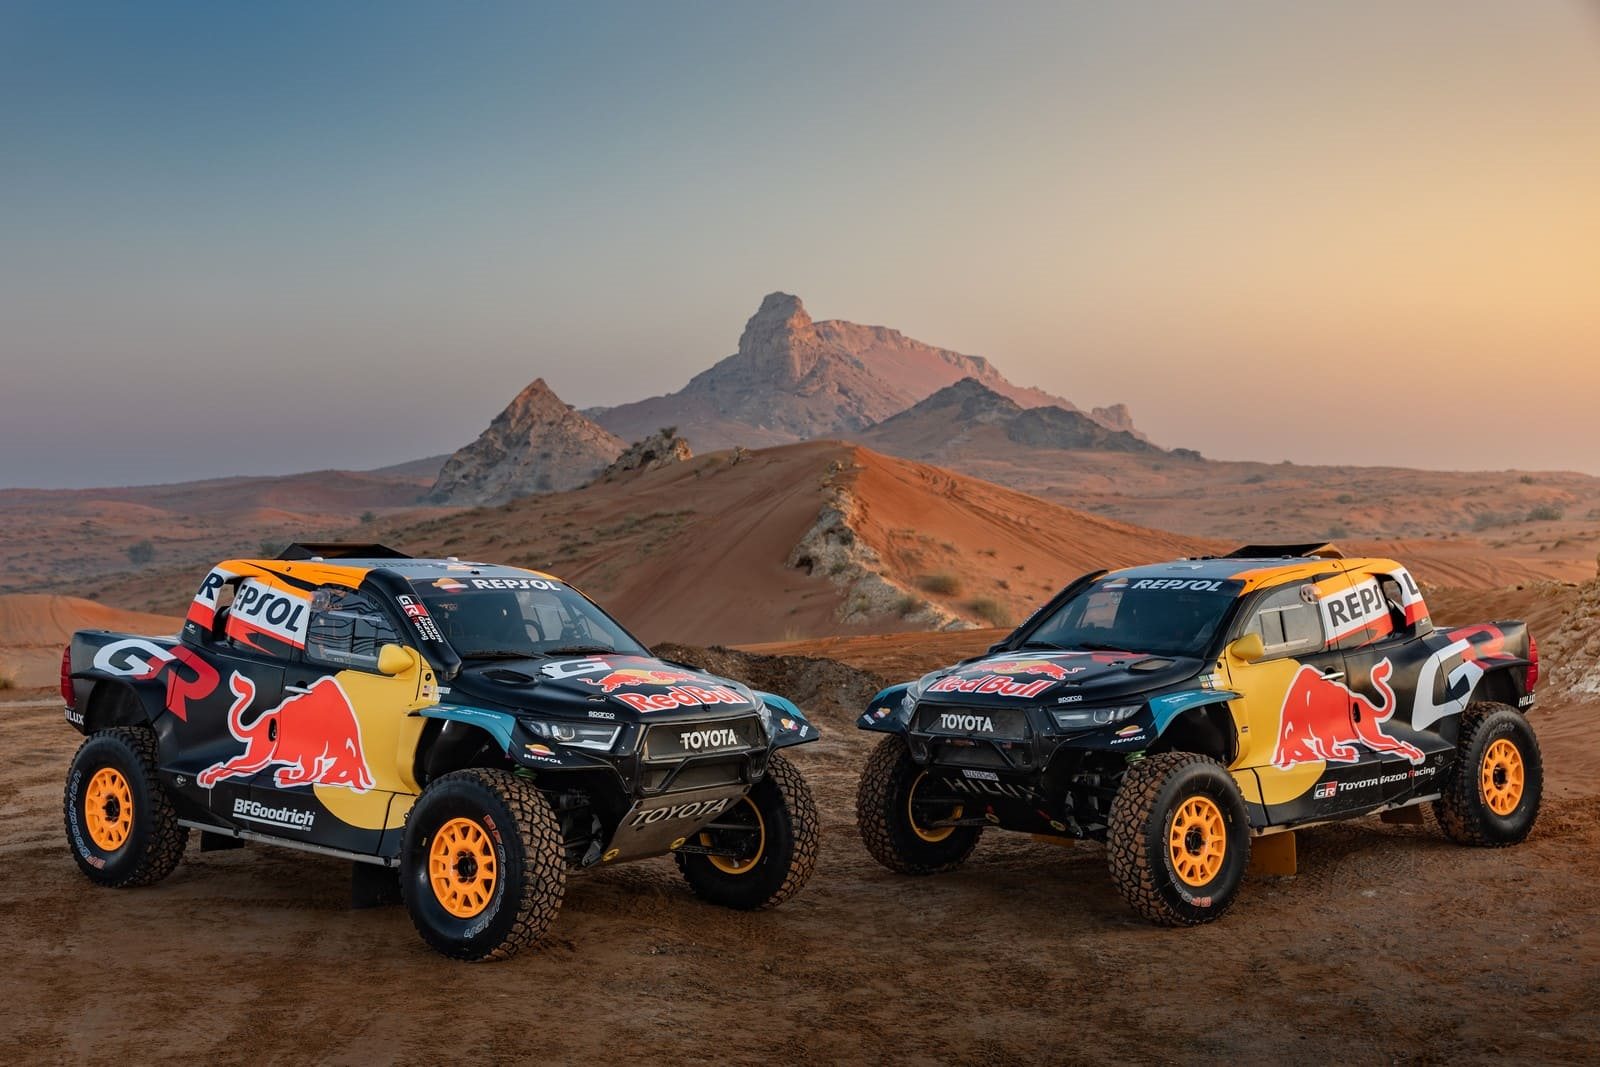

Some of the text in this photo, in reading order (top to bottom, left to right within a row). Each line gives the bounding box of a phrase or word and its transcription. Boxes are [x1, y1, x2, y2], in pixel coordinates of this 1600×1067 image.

[471, 579, 561, 591] REPSOL
[1131, 579, 1223, 592] REPSOL
[396, 595, 421, 617] GR
[93, 638, 221, 722] GR
[927, 675, 1056, 698] Red Bull
[613, 686, 749, 713] Red Bull
[941, 713, 994, 732] TOYOTA
[681, 729, 738, 750] TOYOTA
[1110, 734, 1146, 745] REPSOL
[523, 753, 562, 765] REPSOL
[1314, 783, 1337, 799] GR
[1339, 778, 1378, 791] TOYOTA
[1408, 767, 1435, 779] Racing
[233, 798, 315, 826] BFGoodrich
[631, 798, 729, 826] TOYOTA
